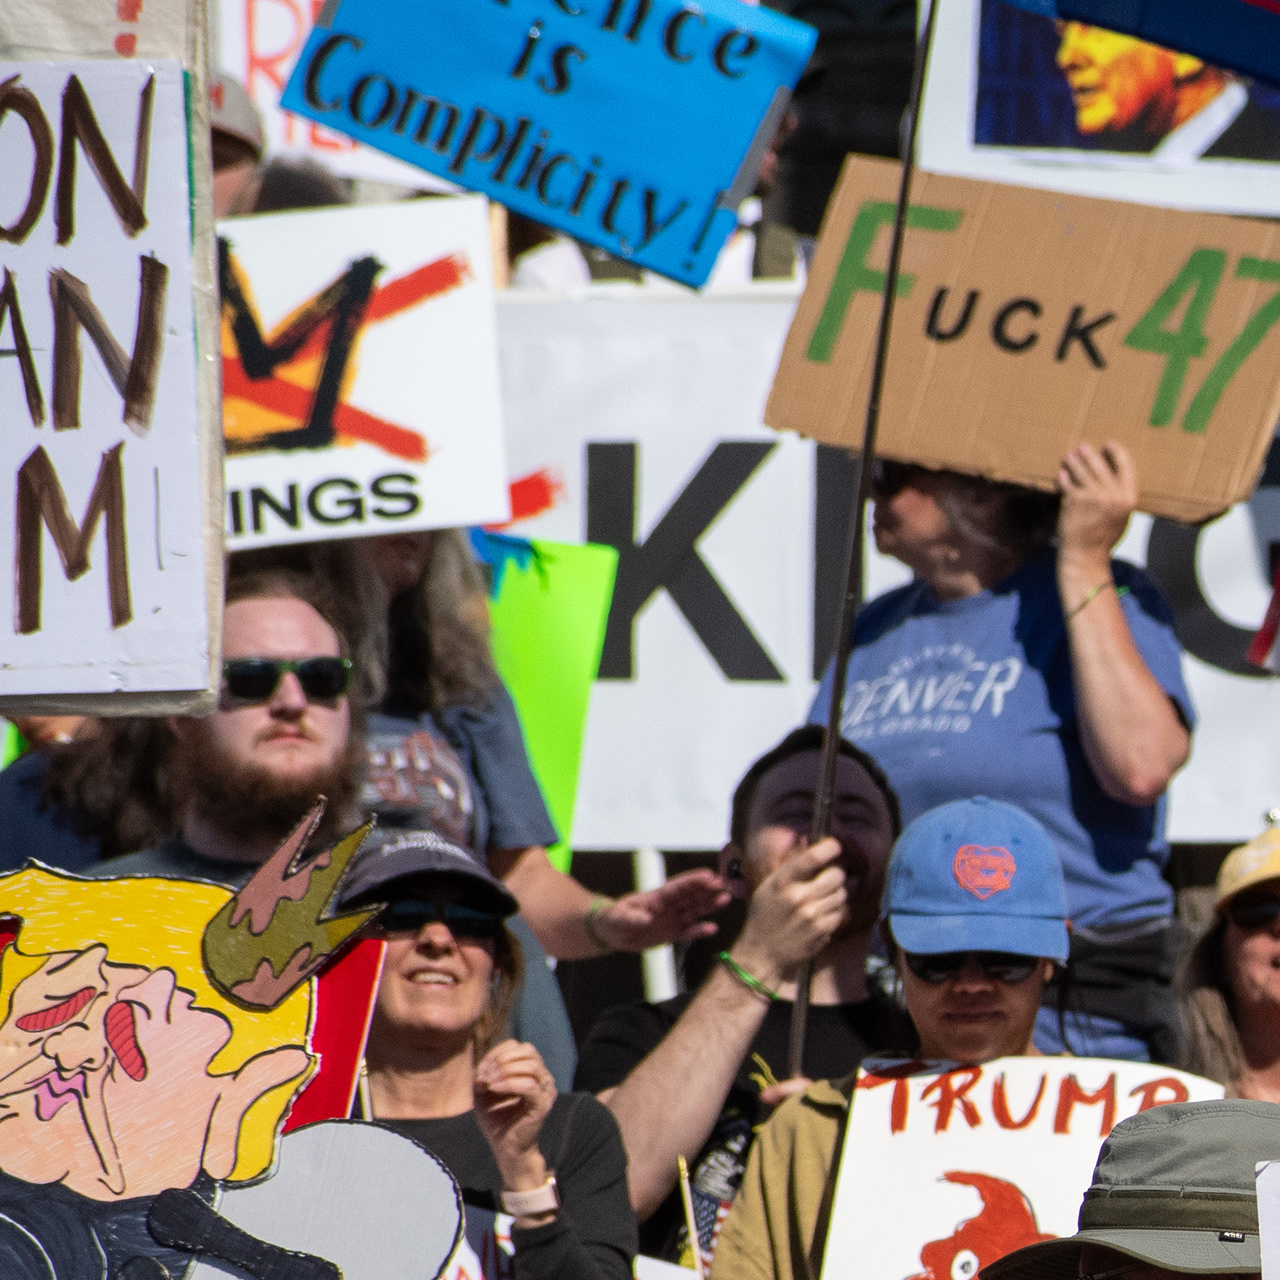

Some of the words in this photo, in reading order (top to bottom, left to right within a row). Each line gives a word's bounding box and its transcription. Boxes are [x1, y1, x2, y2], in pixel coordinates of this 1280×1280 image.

[512, 20, 587, 95] is
[303, 33, 731, 272] Complicity!
[806, 200, 1115, 370] FUCK
[224, 472, 422, 537] INGS
